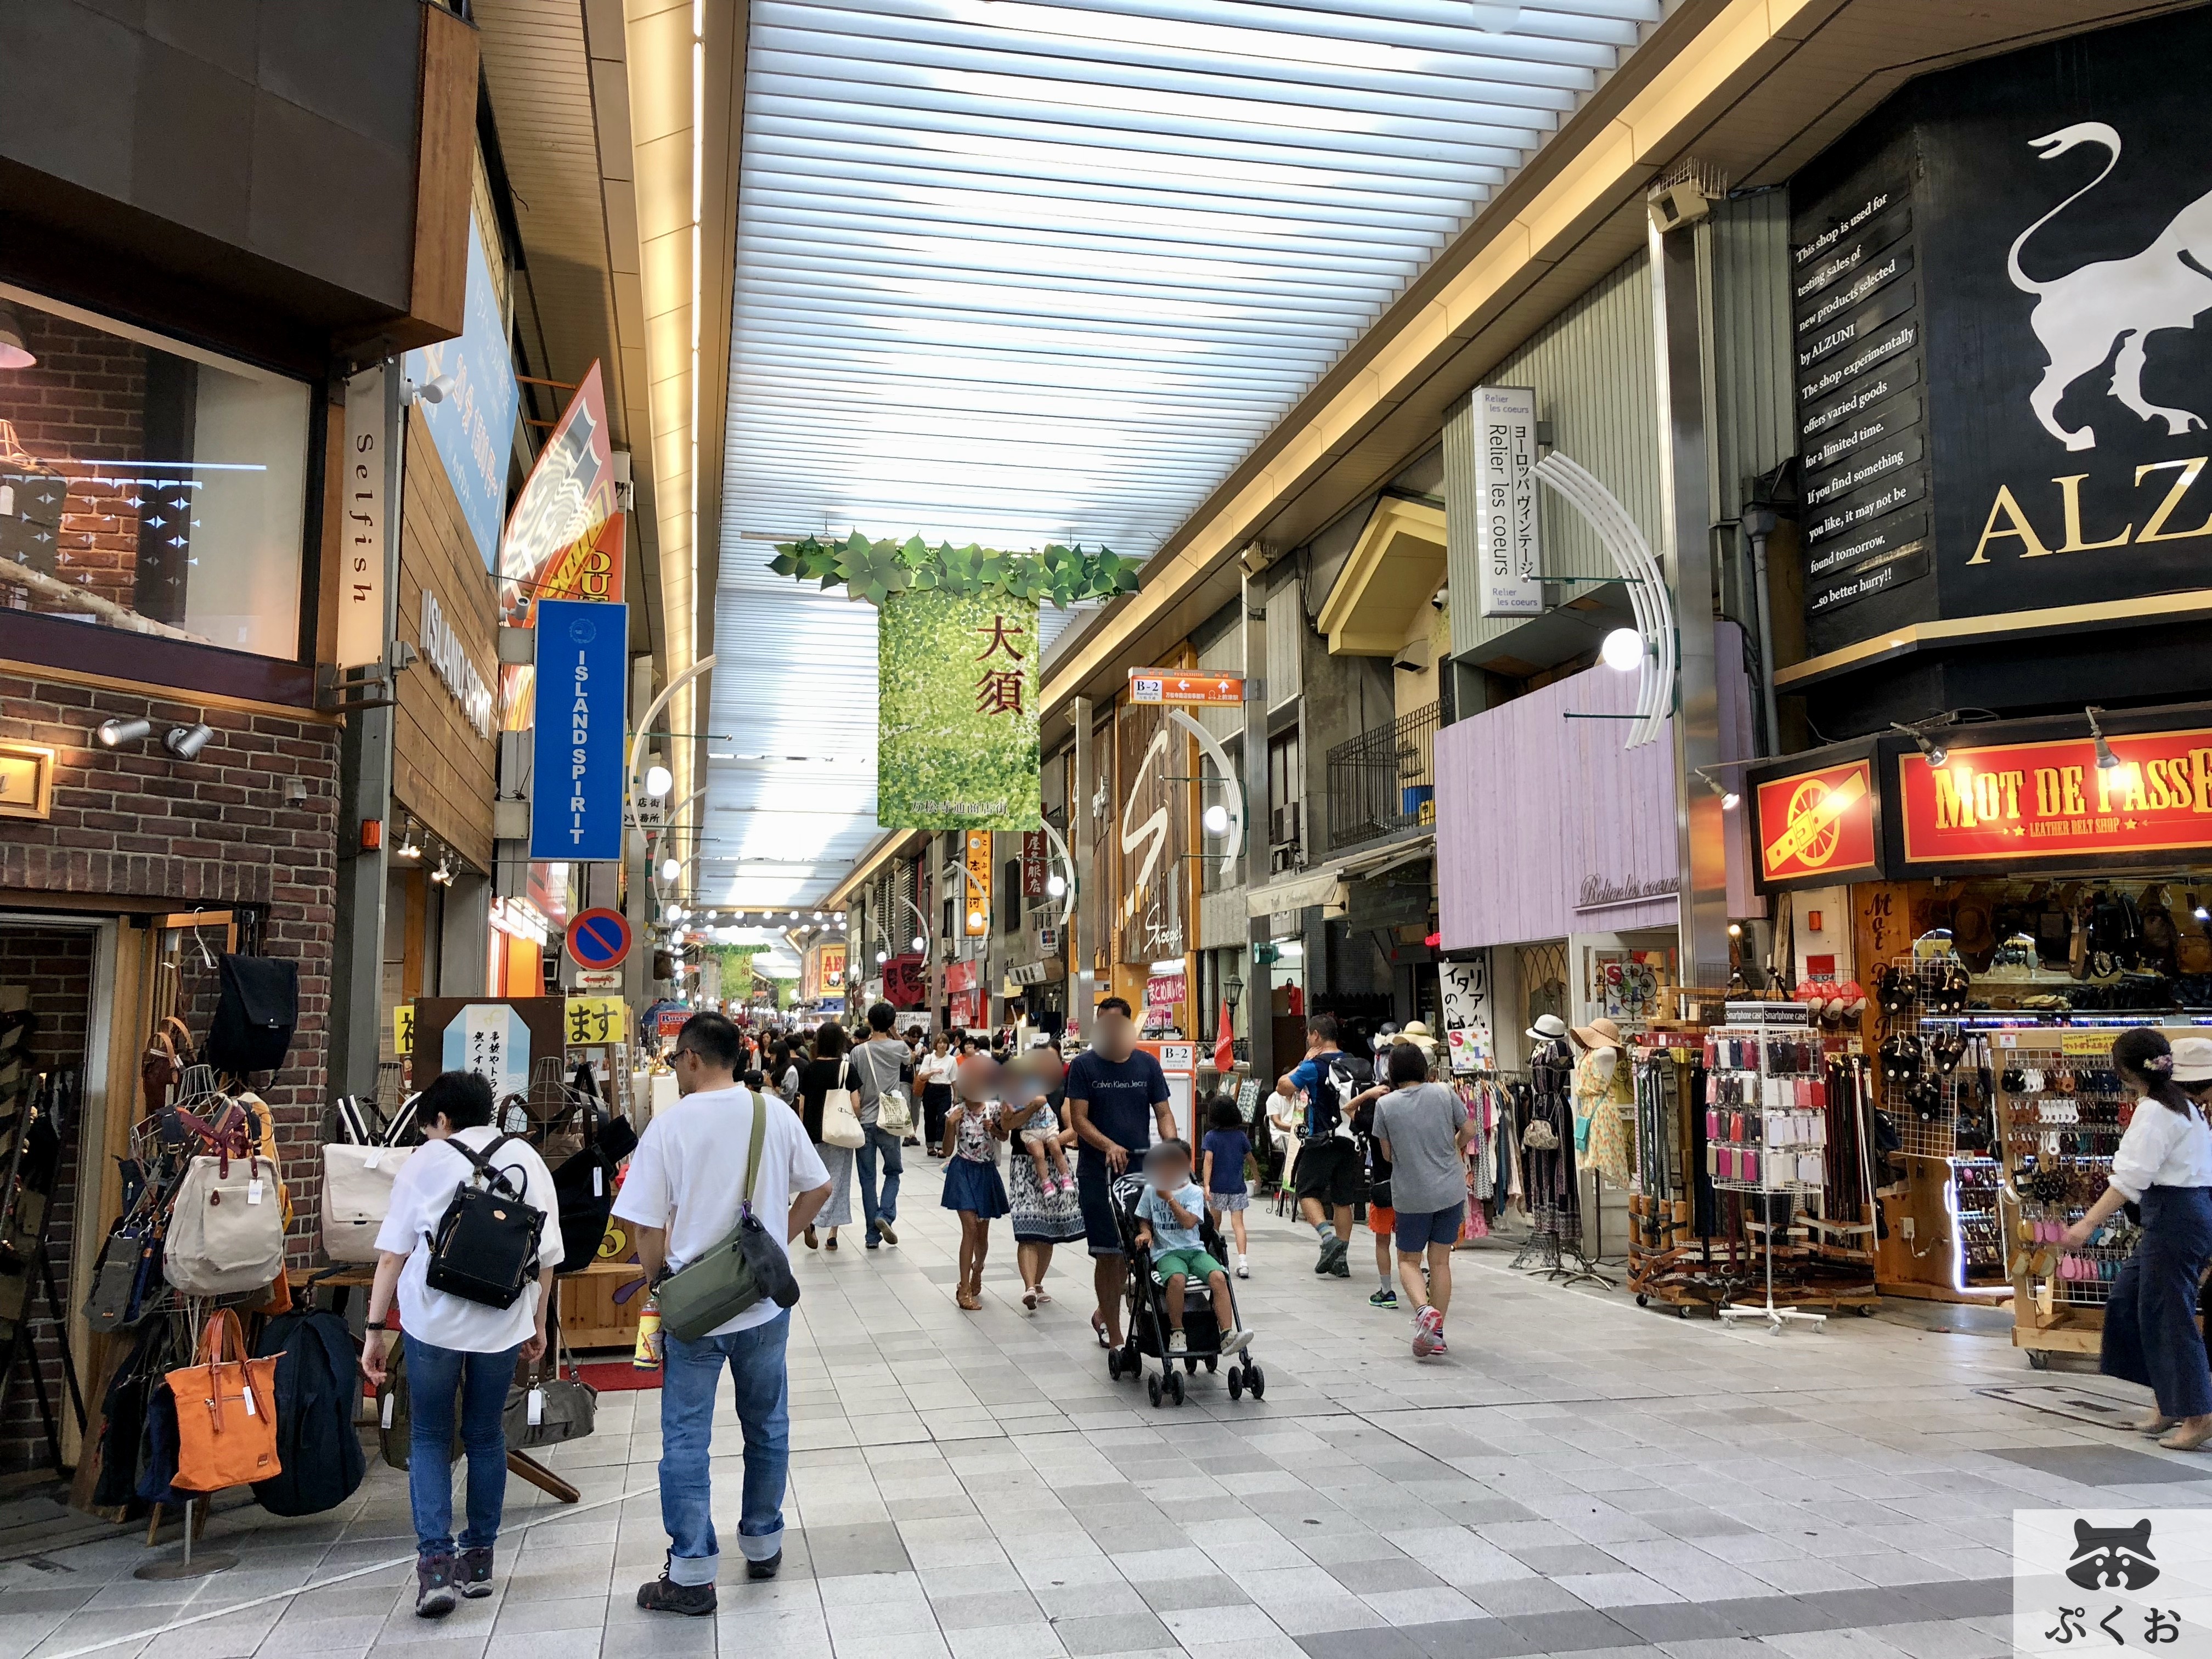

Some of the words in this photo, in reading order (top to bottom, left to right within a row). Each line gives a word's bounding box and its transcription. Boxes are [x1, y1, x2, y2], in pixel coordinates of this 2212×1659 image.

[1796, 244, 1815, 263] This
[1816, 229, 1838, 249] shop
[1841, 222, 1849, 234] is
[1850, 202, 1871, 227] used
[1873, 194, 1888, 211] for
[1798, 273, 1825, 297] testing
[1827, 257, 1849, 277] sales
[1851, 244, 1861, 262] of
[1799, 314, 1817, 331] new
[1818, 287, 1858, 323] products
[1860, 258, 1896, 294] selected
[1800, 352, 1810, 365] by
[1812, 324, 1855, 358] ALZUNI
[1802, 383, 1818, 400] The
[1819, 370, 1842, 389] shop
[1844, 328, 1914, 375] experimentally
[1485, 394, 1508, 403] Relier
[1803, 414, 1826, 434] offers
[1827, 395, 1857, 420] varied
[1859, 381, 1888, 408] goods
[1489, 425, 1508, 474] Relier
[1515, 426, 1531, 490] ヨーロッパ
[1805, 455, 1818, 468] for
[1818, 450, 1822, 461] a
[1824, 431, 1858, 458] limited
[1860, 423, 1884, 441] time.
[1492, 483, 1509, 507] les
[1807, 491, 1816, 504] If
[1816, 484, 1830, 501] you
[1832, 472, 1852, 490] find
[1854, 450, 1904, 482] something
[349, 433, 373, 604] Selfish
[1809, 526, 1824, 542] you
[1825, 517, 1844, 536] like,
[1846, 511, 1853, 522] it
[1855, 503, 1875, 518] may
[1876, 493, 1892, 509] not
[1894, 487, 1906, 501] be
[1966, 456, 2212, 566] ALZ
[1492, 516, 1508, 576] coeurs
[1810, 554, 1834, 574] found
[1836, 535, 1886, 561] tomorrow.
[1511, 598, 1538, 606] coeurs
[1830, 584, 1857, 602] better
[1860, 567, 1892, 592] hurry!!
[420, 589, 465, 699] ISLAND
[464, 658, 492, 740] SPIRIT
[975, 614, 1025, 715] 大須
[1137, 681, 1159, 691] B-2
[572, 650, 589, 745] ISLAND
[569, 748, 586, 844] SPIRIT
[2034, 765, 2085, 816] DE
[2029, 820, 2069, 837] LEATHER
[2072, 818, 2094, 835] BELT
[2096, 817, 2121, 834] SHOP
[1580, 873, 1624, 905] Relier
[1625, 874, 1640, 898] les
[568, 1003, 618, 1042] ます
[1726, 1010, 1752, 1021] Smartphone
[1752, 1012, 1762, 1020] case
[1764, 1010, 1794, 1021] Smartphone
[1795, 1012, 1807, 1020] case
[1165, 1048, 1188, 1058] B-2
[1449, 1031, 1494, 1069] SALE
[1092, 1080, 1113, 1089] Calvin
[1113, 1080, 1130, 1089] Klein
